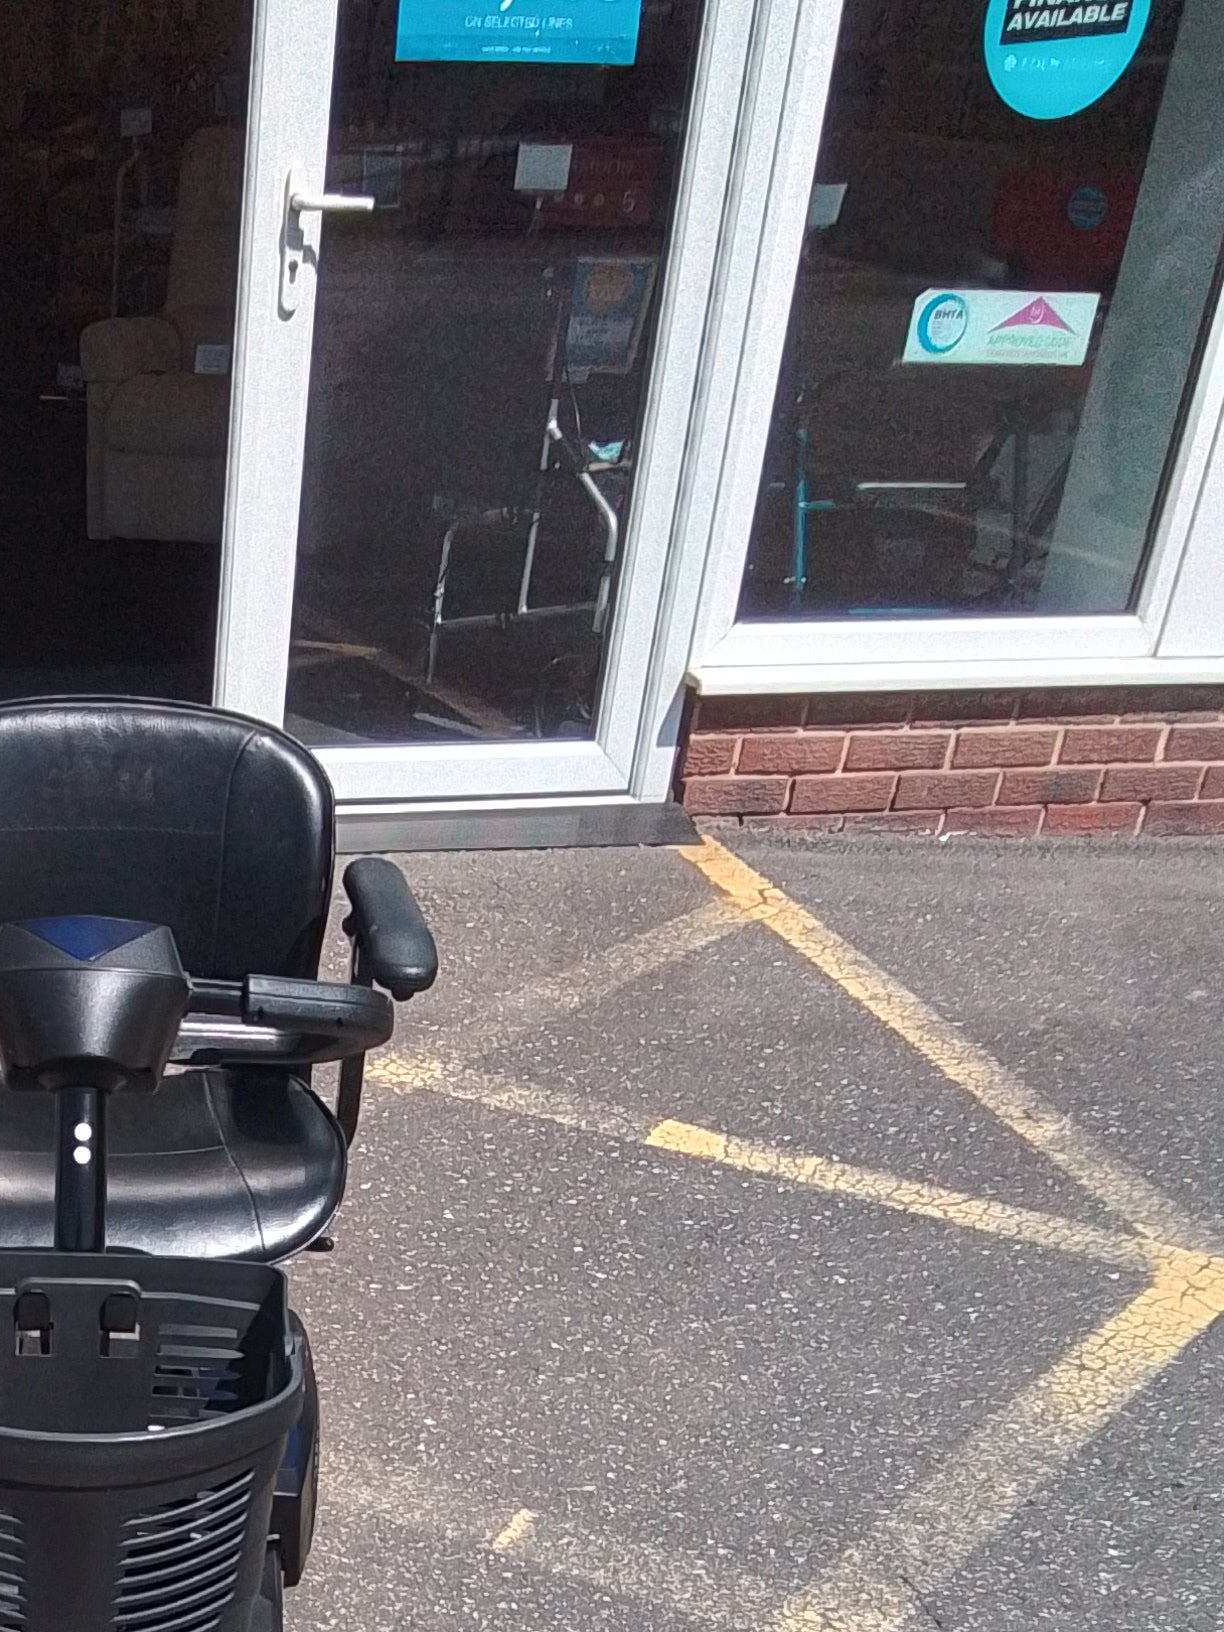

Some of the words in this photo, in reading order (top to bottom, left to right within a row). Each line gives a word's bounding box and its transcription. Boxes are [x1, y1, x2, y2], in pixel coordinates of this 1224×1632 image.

[484, 15, 540, 29] SELECTED
[1006, 2, 1129, 32] AVAILABLE
[933, 308, 964, 320] BHTA
